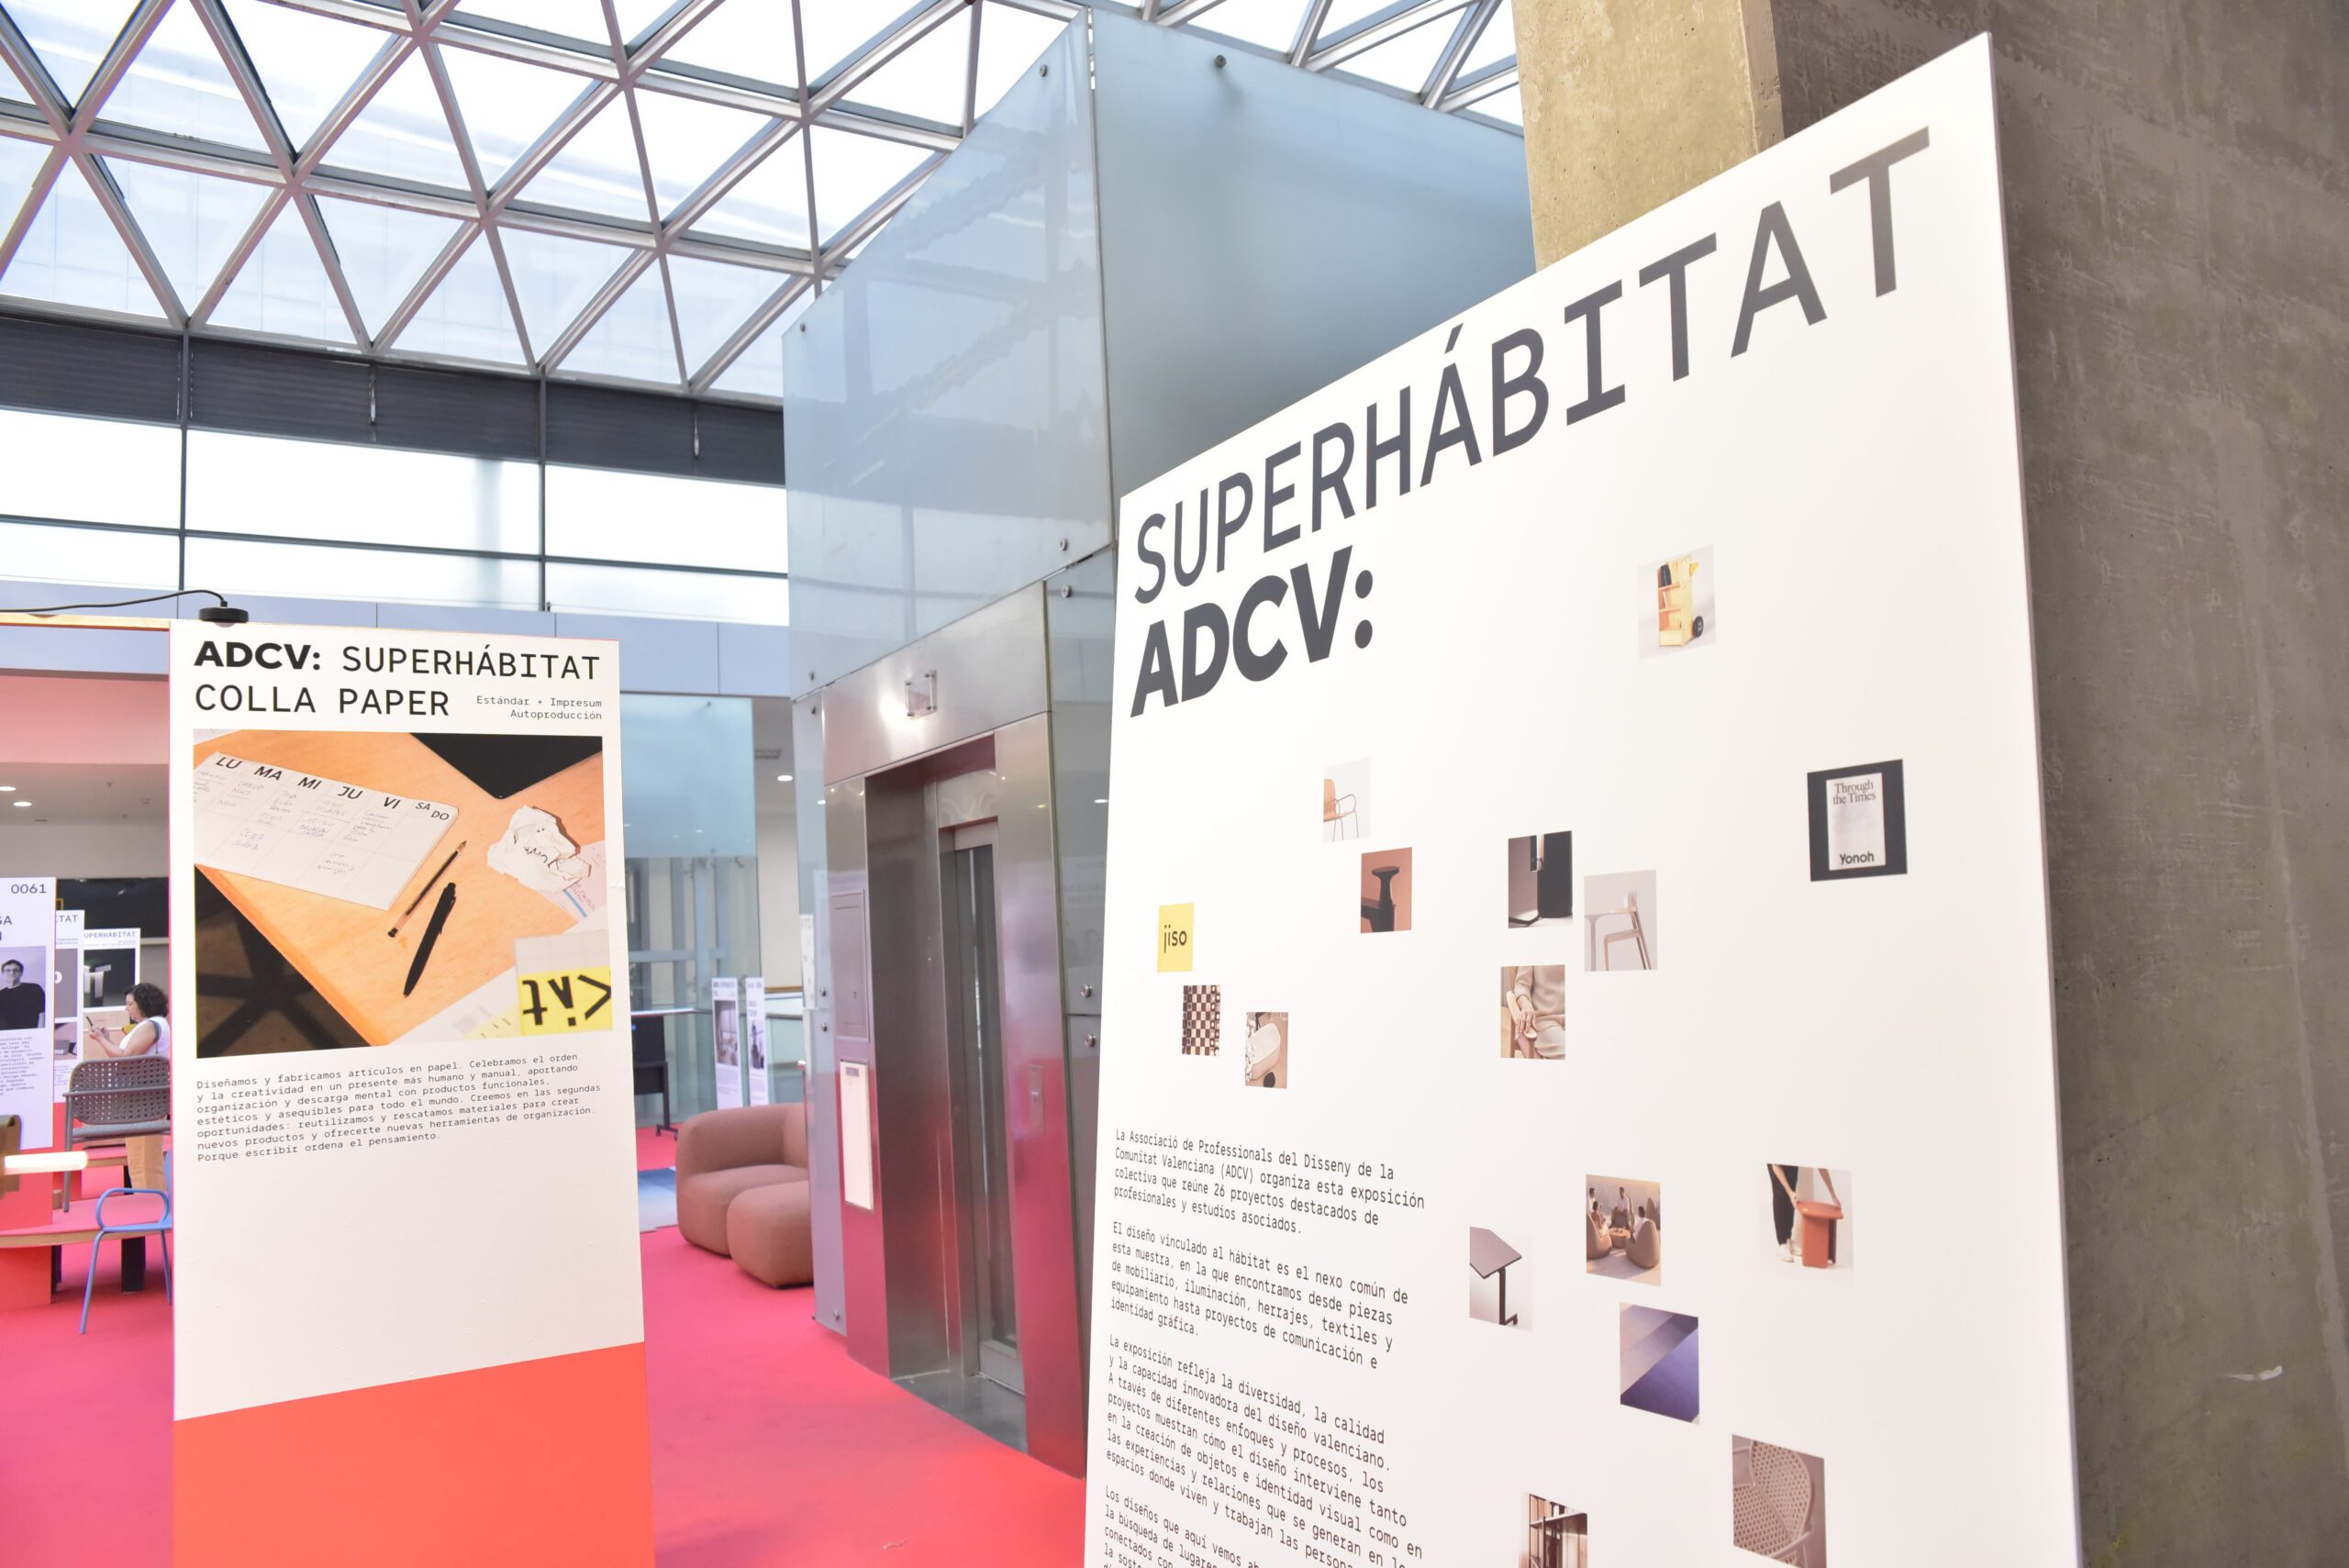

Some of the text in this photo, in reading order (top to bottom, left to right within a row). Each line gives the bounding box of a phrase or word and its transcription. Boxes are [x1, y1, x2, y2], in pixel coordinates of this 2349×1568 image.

[1134, 126, 1930, 604] SUPERHÁBITAT
[1130, 545, 1374, 717] ADCV:
[194, 639, 601, 681] ADCV: SUPERHÁBITAT
[195, 684, 450, 717] COLLA PAPER
[476, 695, 529, 706] Estándar
[550, 698, 602, 710] Impresum
[510, 709, 603, 720] Autoproducción
[216, 757, 430, 811] LU MA MI JU VI SA
[1833, 791, 1876, 805] the Times
[1834, 779, 1874, 795] Through
[431, 810, 450, 821] DO
[1840, 851, 1875, 865] Yonoh
[11, 884, 47, 894] 0061
[1163, 924, 1187, 954] jiso
[196, 1078, 258, 1090] Diseñamos
[278, 1072, 341, 1084] fabricamos
[348, 1066, 404, 1078] artículos
[409, 1065, 422, 1073] en
[469, 1058, 528, 1069] Celebramos
[532, 1055, 544, 1064] el
[549, 1053, 578, 1062] orden
[196, 1100, 278, 1114] organización
[297, 1095, 349, 1106] descarga
[354, 1089, 393, 1100] mental
[398, 1089, 417, 1097] con
[422, 1084, 476, 1096] productos
[196, 1114, 258, 1126] estéticos
[278, 1106, 342, 1118] asequibles
[349, 1104, 374, 1114] para
[380, 1100, 406, 1110] todo
[410, 1098, 423, 1107] el
[470, 1093, 511, 1102] Creemos
[535, 1088, 551, 1097] las
[557, 1084, 601, 1095] segundas
[197, 1140, 239, 1150] nuevos
[245, 1133, 305, 1147] productos
[324, 1126, 381, 1139] ofrecerte
[386, 1123, 424, 1132] nuevas
[429, 1116, 500, 1129] herramientas
[506, 1113, 518, 1121] de
[197, 1151, 239, 1162] Porque
[245, 1144, 298, 1158] escribir
[305, 1141, 343, 1151] ordena
[350, 1138, 362, 1148] el
[1116, 1129, 1394, 1180] La Associació de Professionals del Disseny de la
[1115, 1146, 1424, 1209] Comunitat Valenciana (ADCV) organiza esta exposición
[1115, 1166, 1379, 1226] colectiva que reúne 26 proyectos destacados de
[1114, 1185, 1301, 1234] profesionales y estudios asociados.
[1113, 1220, 1408, 1305] El diseño vinculado al hábitat es el nexo común de
[1112, 1242, 1393, 1326] esta muestra, en la que encontramos desde piezas
[1110, 1296, 1199, 1336] identidad gráfica.
[1111, 1260, 1393, 1351] de mobiliario, iluminación, herrajes, textiles y
[1111, 1280, 1377, 1370] equipamiento hasta proyectos de comunicación e
[1109, 1334, 1385, 1445] La exposición refleja la diversidad, la calidad
[1108, 1354, 1389, 1472] y la capacidad innovadora del diseño valenciano.
[1108, 1372, 1384, 1494] A través de diferentes enfoques y procesos, los
[1106, 1485, 1119, 1504] Los
[1123, 1496, 1159, 1524] diseños
[1163, 1518, 1180, 1535] que
[1185, 1529, 1207, 1550] aquí
[1212, 1542, 1241, 1567] vemos
